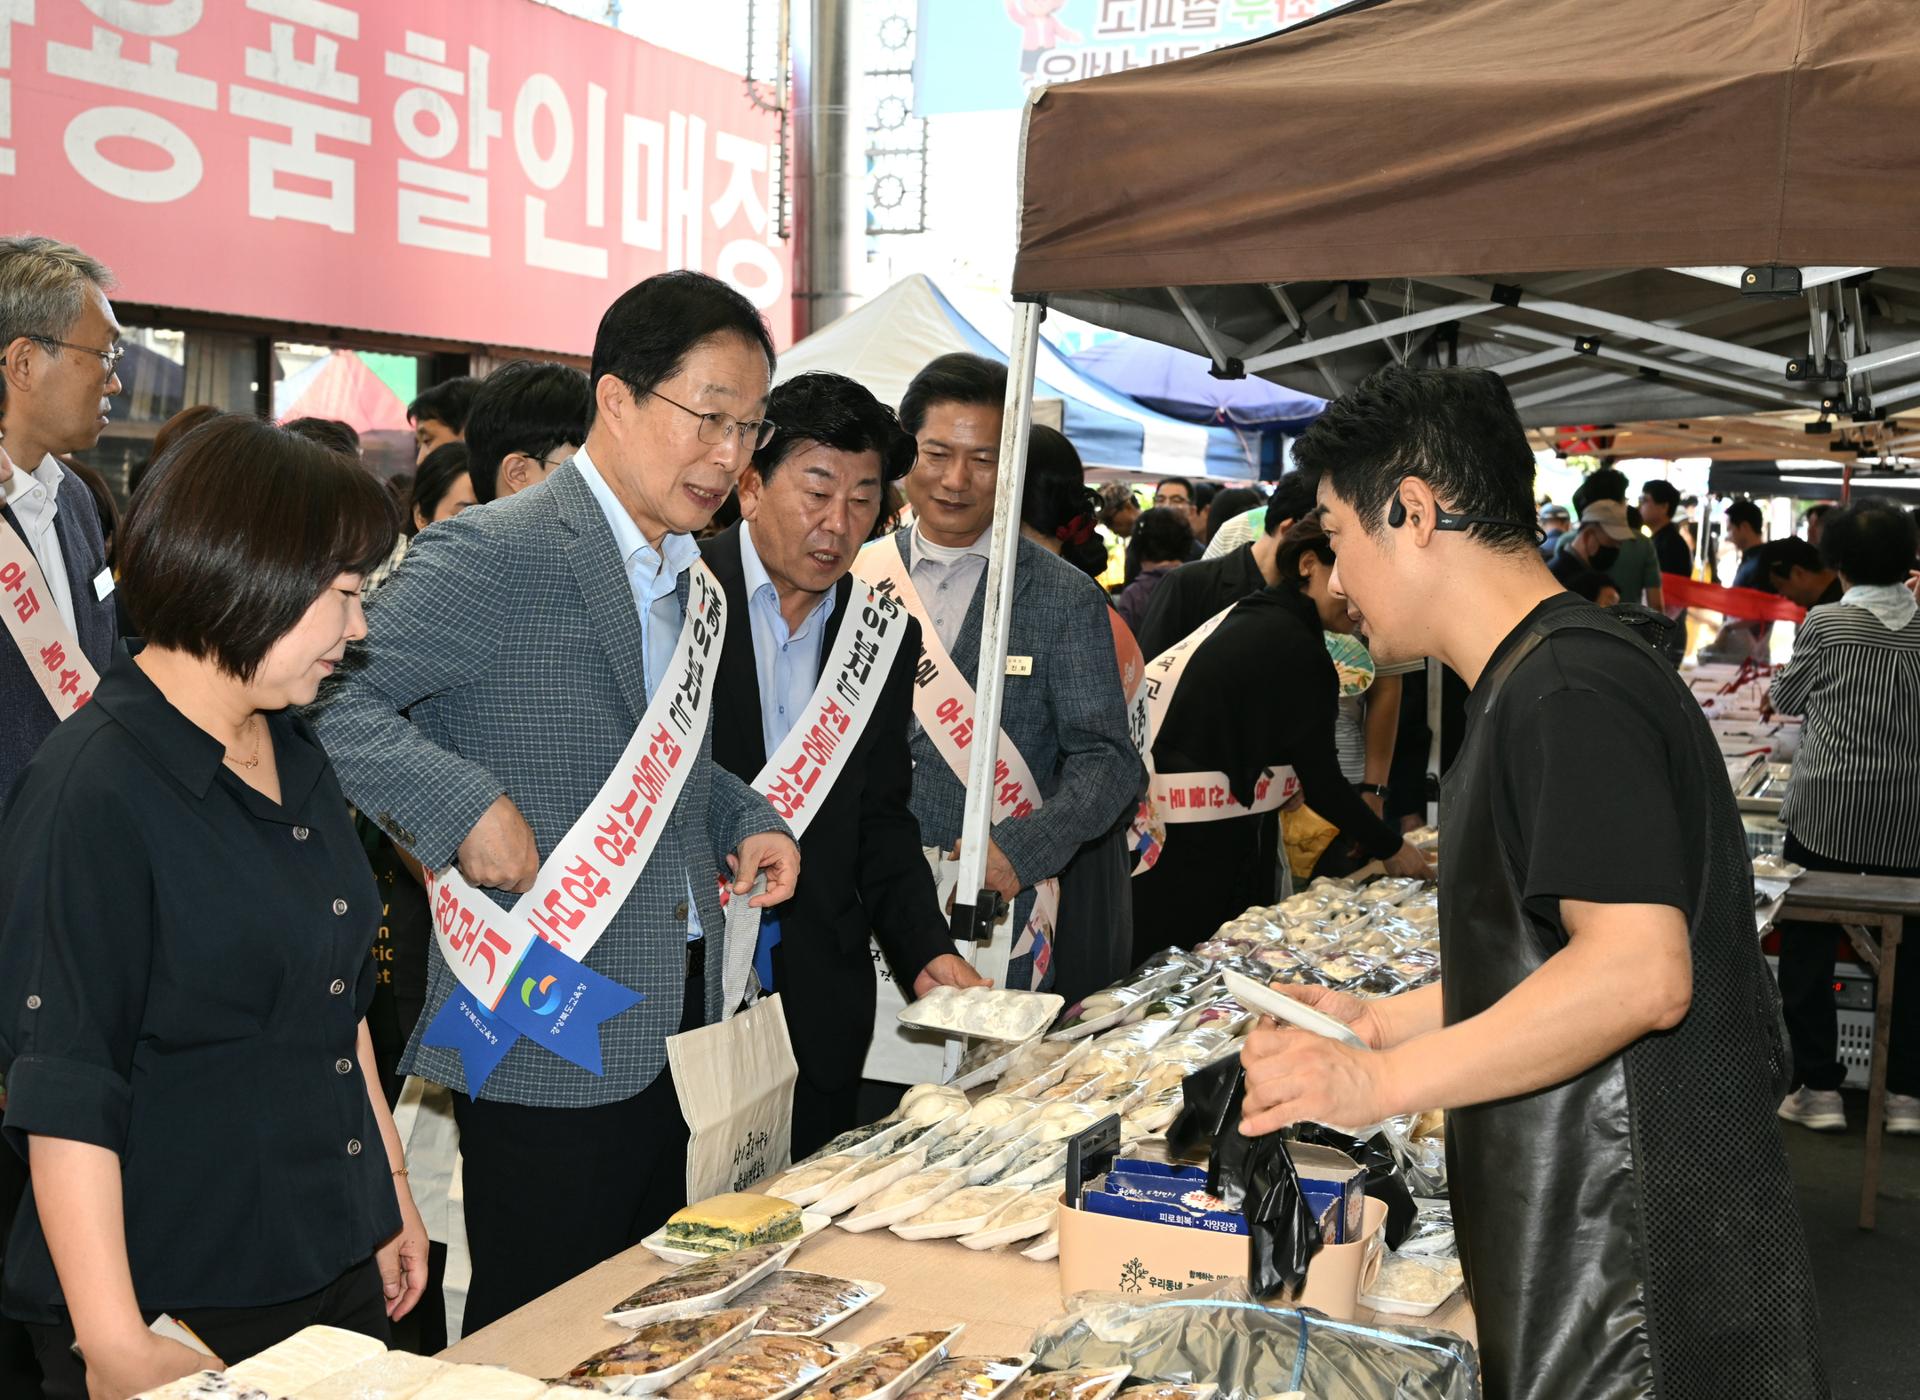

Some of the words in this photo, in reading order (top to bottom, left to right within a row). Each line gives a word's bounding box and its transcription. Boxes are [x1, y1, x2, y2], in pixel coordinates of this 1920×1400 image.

[668, 645, 704, 735] 넘치는
[836, 629, 879, 707] 넘치는
[593, 721, 682, 867] 전통시장
[767, 696, 851, 819] 전통시장
[434, 884, 512, 985] 장보기
[528, 854, 612, 951] 장보
[1159, 1212, 1192, 1226] 피로회복
[1203, 1219, 1238, 1233] 자양강장
[1149, 1276, 1183, 1292] 우리동네
